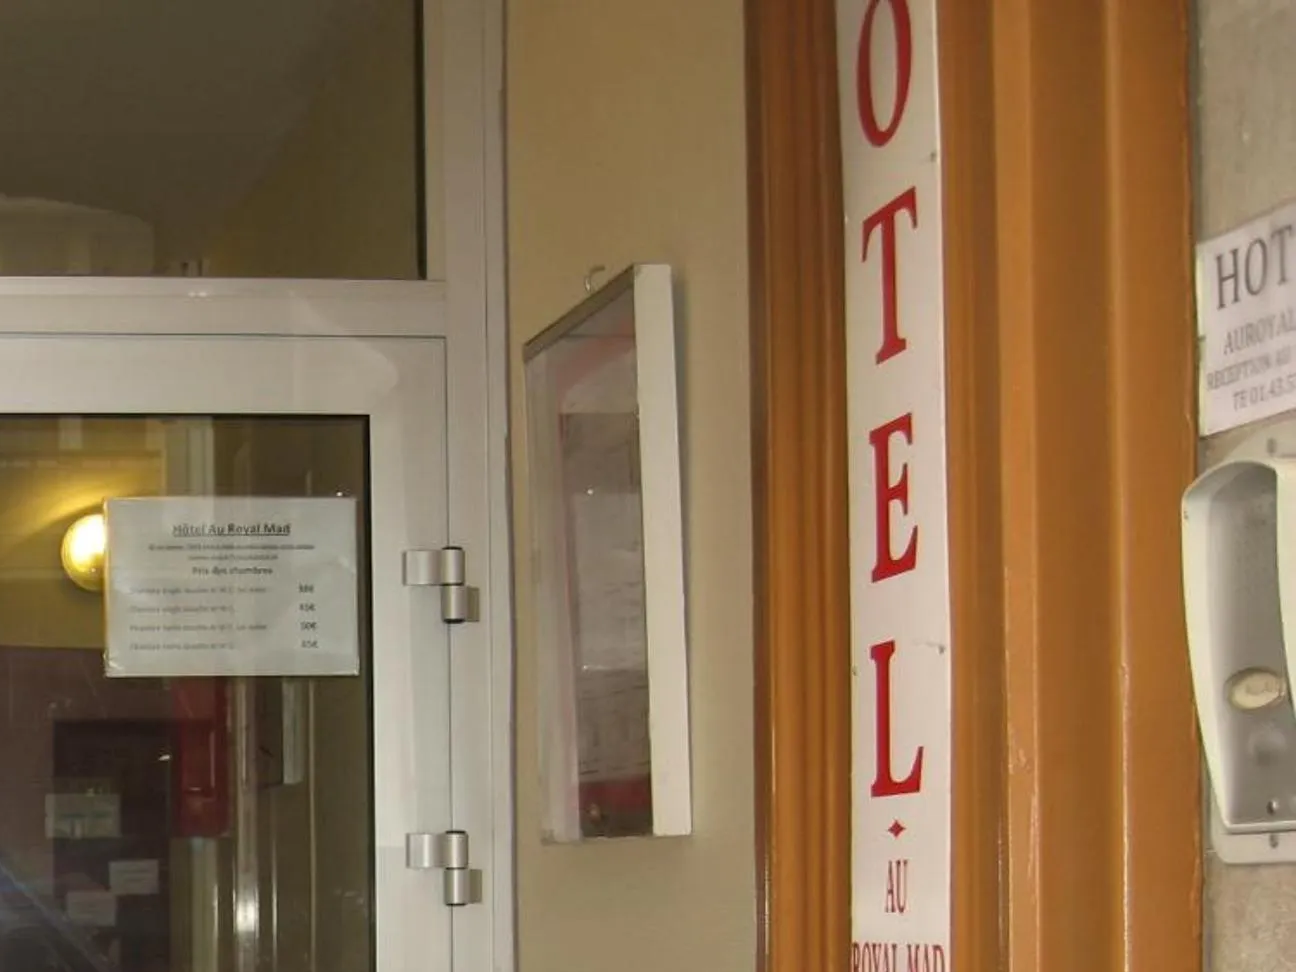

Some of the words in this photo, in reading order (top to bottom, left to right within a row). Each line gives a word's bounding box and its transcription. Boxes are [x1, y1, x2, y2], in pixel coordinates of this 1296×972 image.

[209, 524, 225, 536] Au
[227, 523, 260, 536] Royal
[263, 522, 292, 535] Mad
[885, 860, 908, 913] AU
